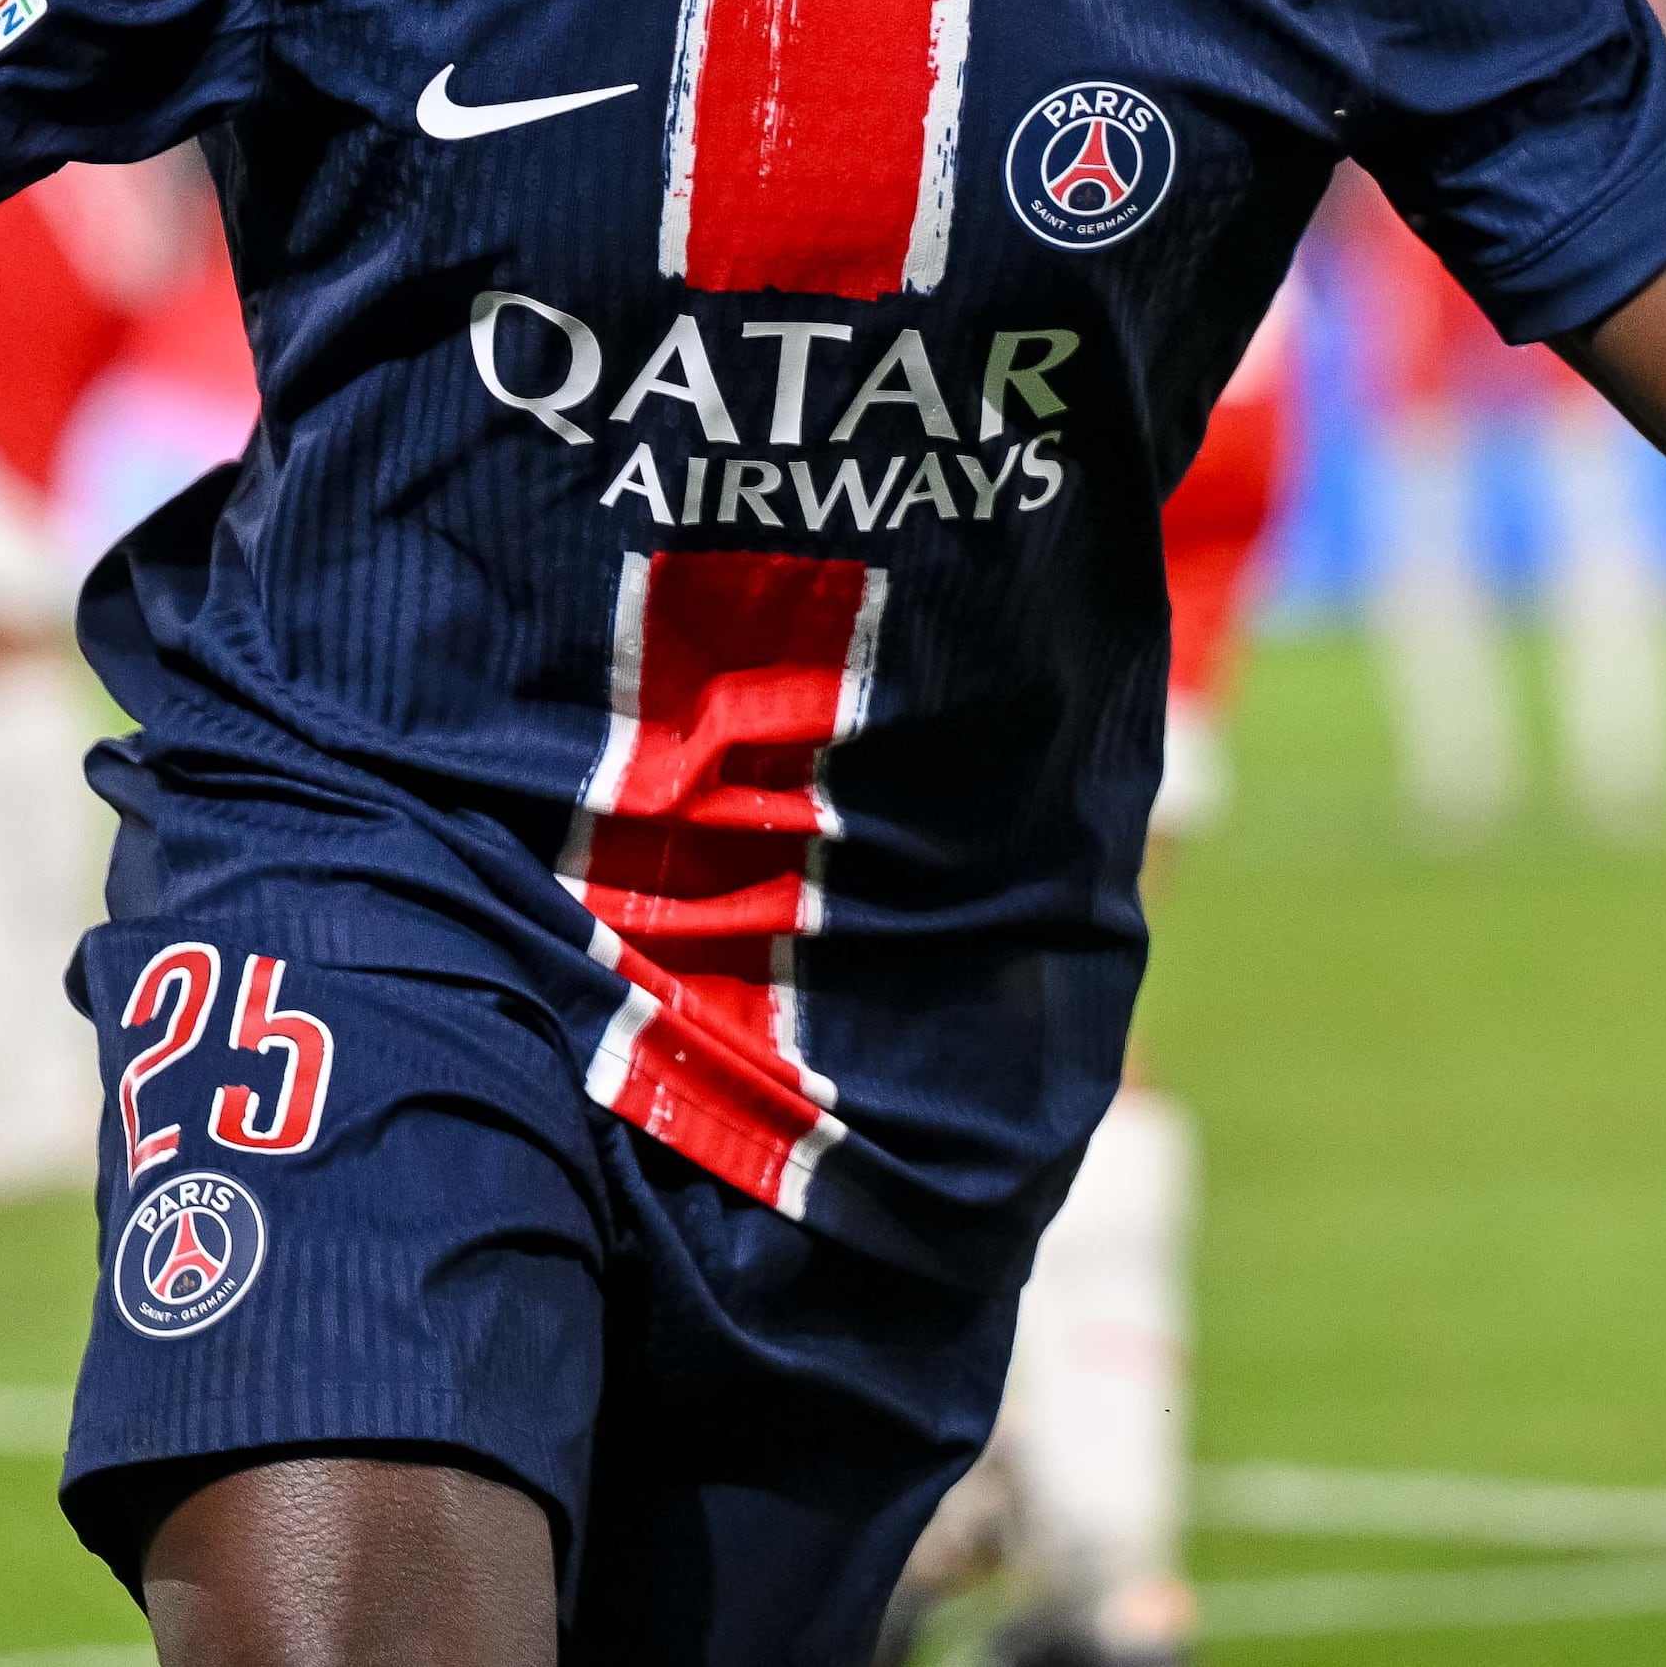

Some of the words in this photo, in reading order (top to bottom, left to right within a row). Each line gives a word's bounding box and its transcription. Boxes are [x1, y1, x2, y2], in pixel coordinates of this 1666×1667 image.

[1042, 90, 1154, 133] PARIS
[470, 290, 1080, 446] QATAR
[599, 430, 1064, 532] AIRWAYS
[119, 941, 334, 1191] 25
[137, 1182, 235, 1234] PARIS
